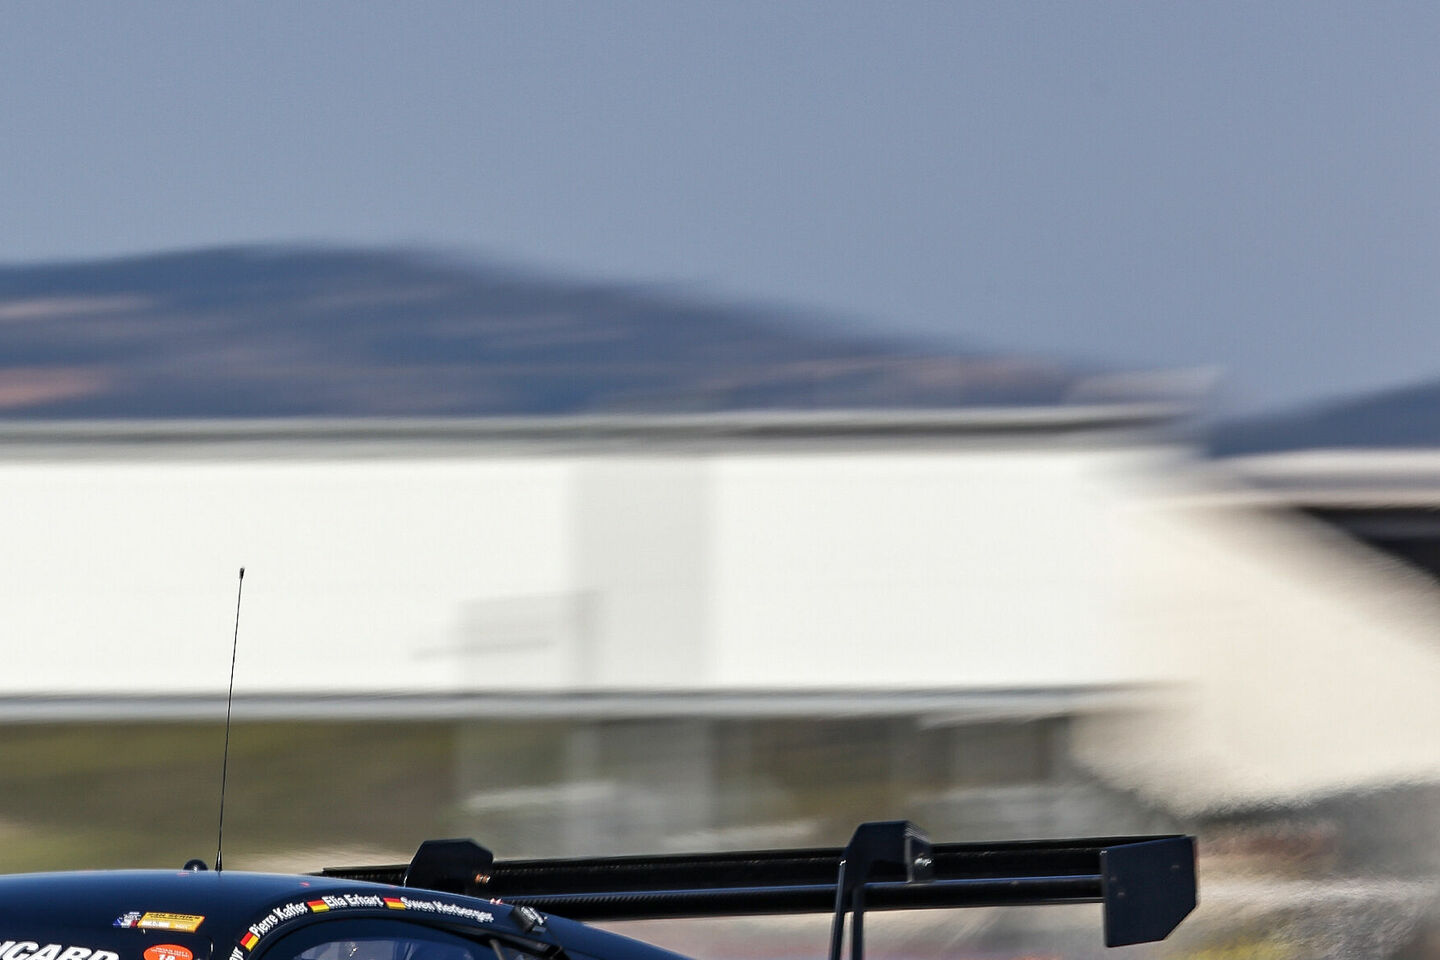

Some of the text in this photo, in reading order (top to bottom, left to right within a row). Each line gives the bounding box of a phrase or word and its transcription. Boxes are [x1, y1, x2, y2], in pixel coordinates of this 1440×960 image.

[321, 894, 384, 908] Elia Erhart
[248, 902, 308, 939] Pierre Kaffer
